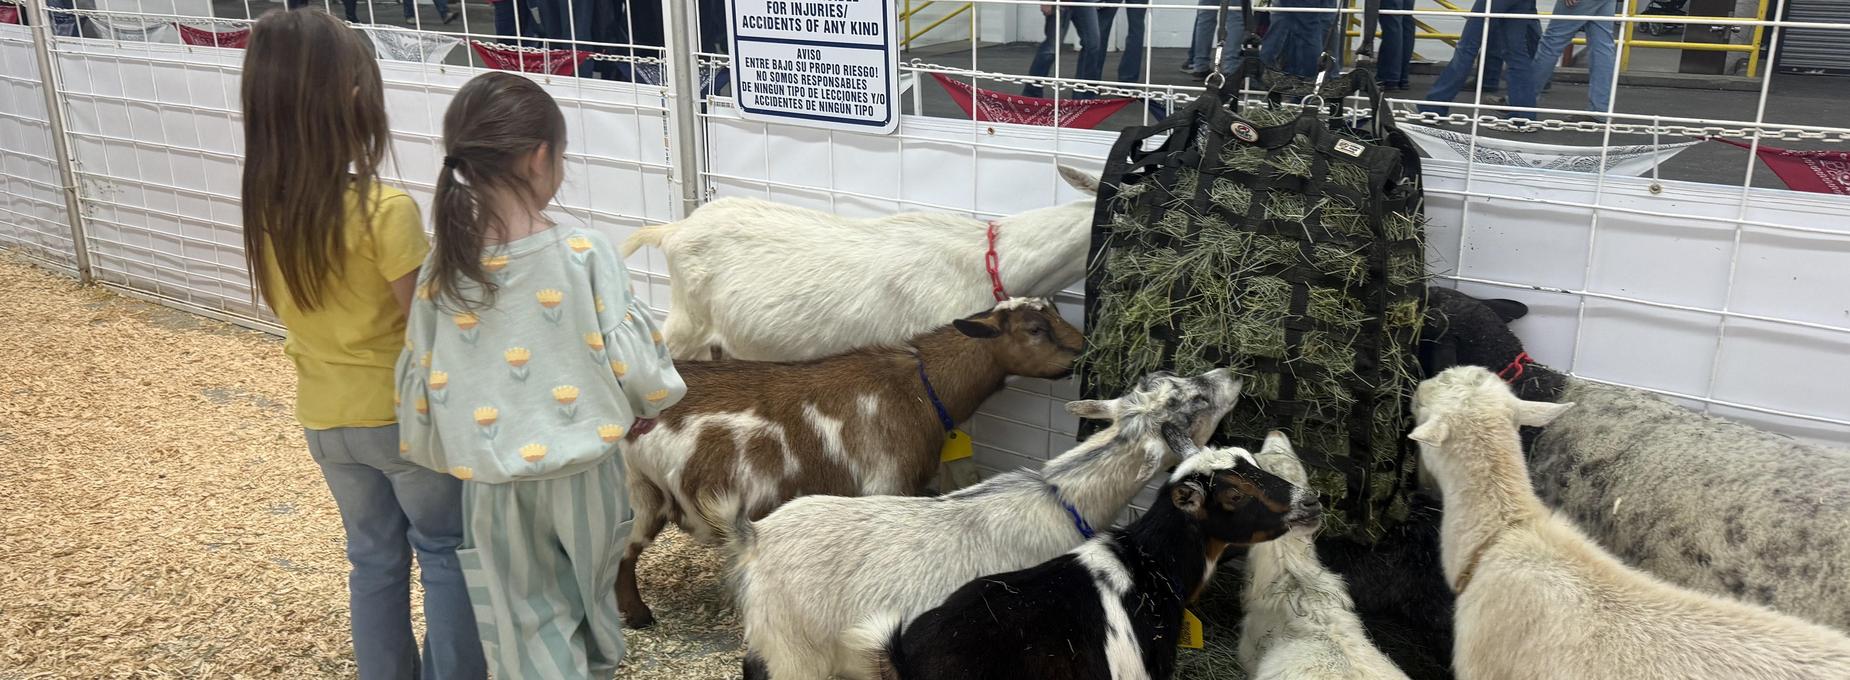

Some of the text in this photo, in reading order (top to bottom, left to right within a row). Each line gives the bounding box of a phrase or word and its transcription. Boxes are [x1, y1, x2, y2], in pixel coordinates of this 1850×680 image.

[767, 1, 848, 18] FOR INJURIES/
[742, 15, 879, 36] ACCIDENTS OF ANY KIND
[797, 48, 821, 61] AVISO
[745, 57, 878, 78] ENTRE BAJO SU PROPIO RIESGO!
[756, 70, 867, 90] NO SOMOS RESPONSABLES
[742, 81, 885, 105] DE NINGÚN TIPO DE LECCIONES Y/O
[754, 96, 874, 117] ACCIDENTES DE NINGÚN TIPO
